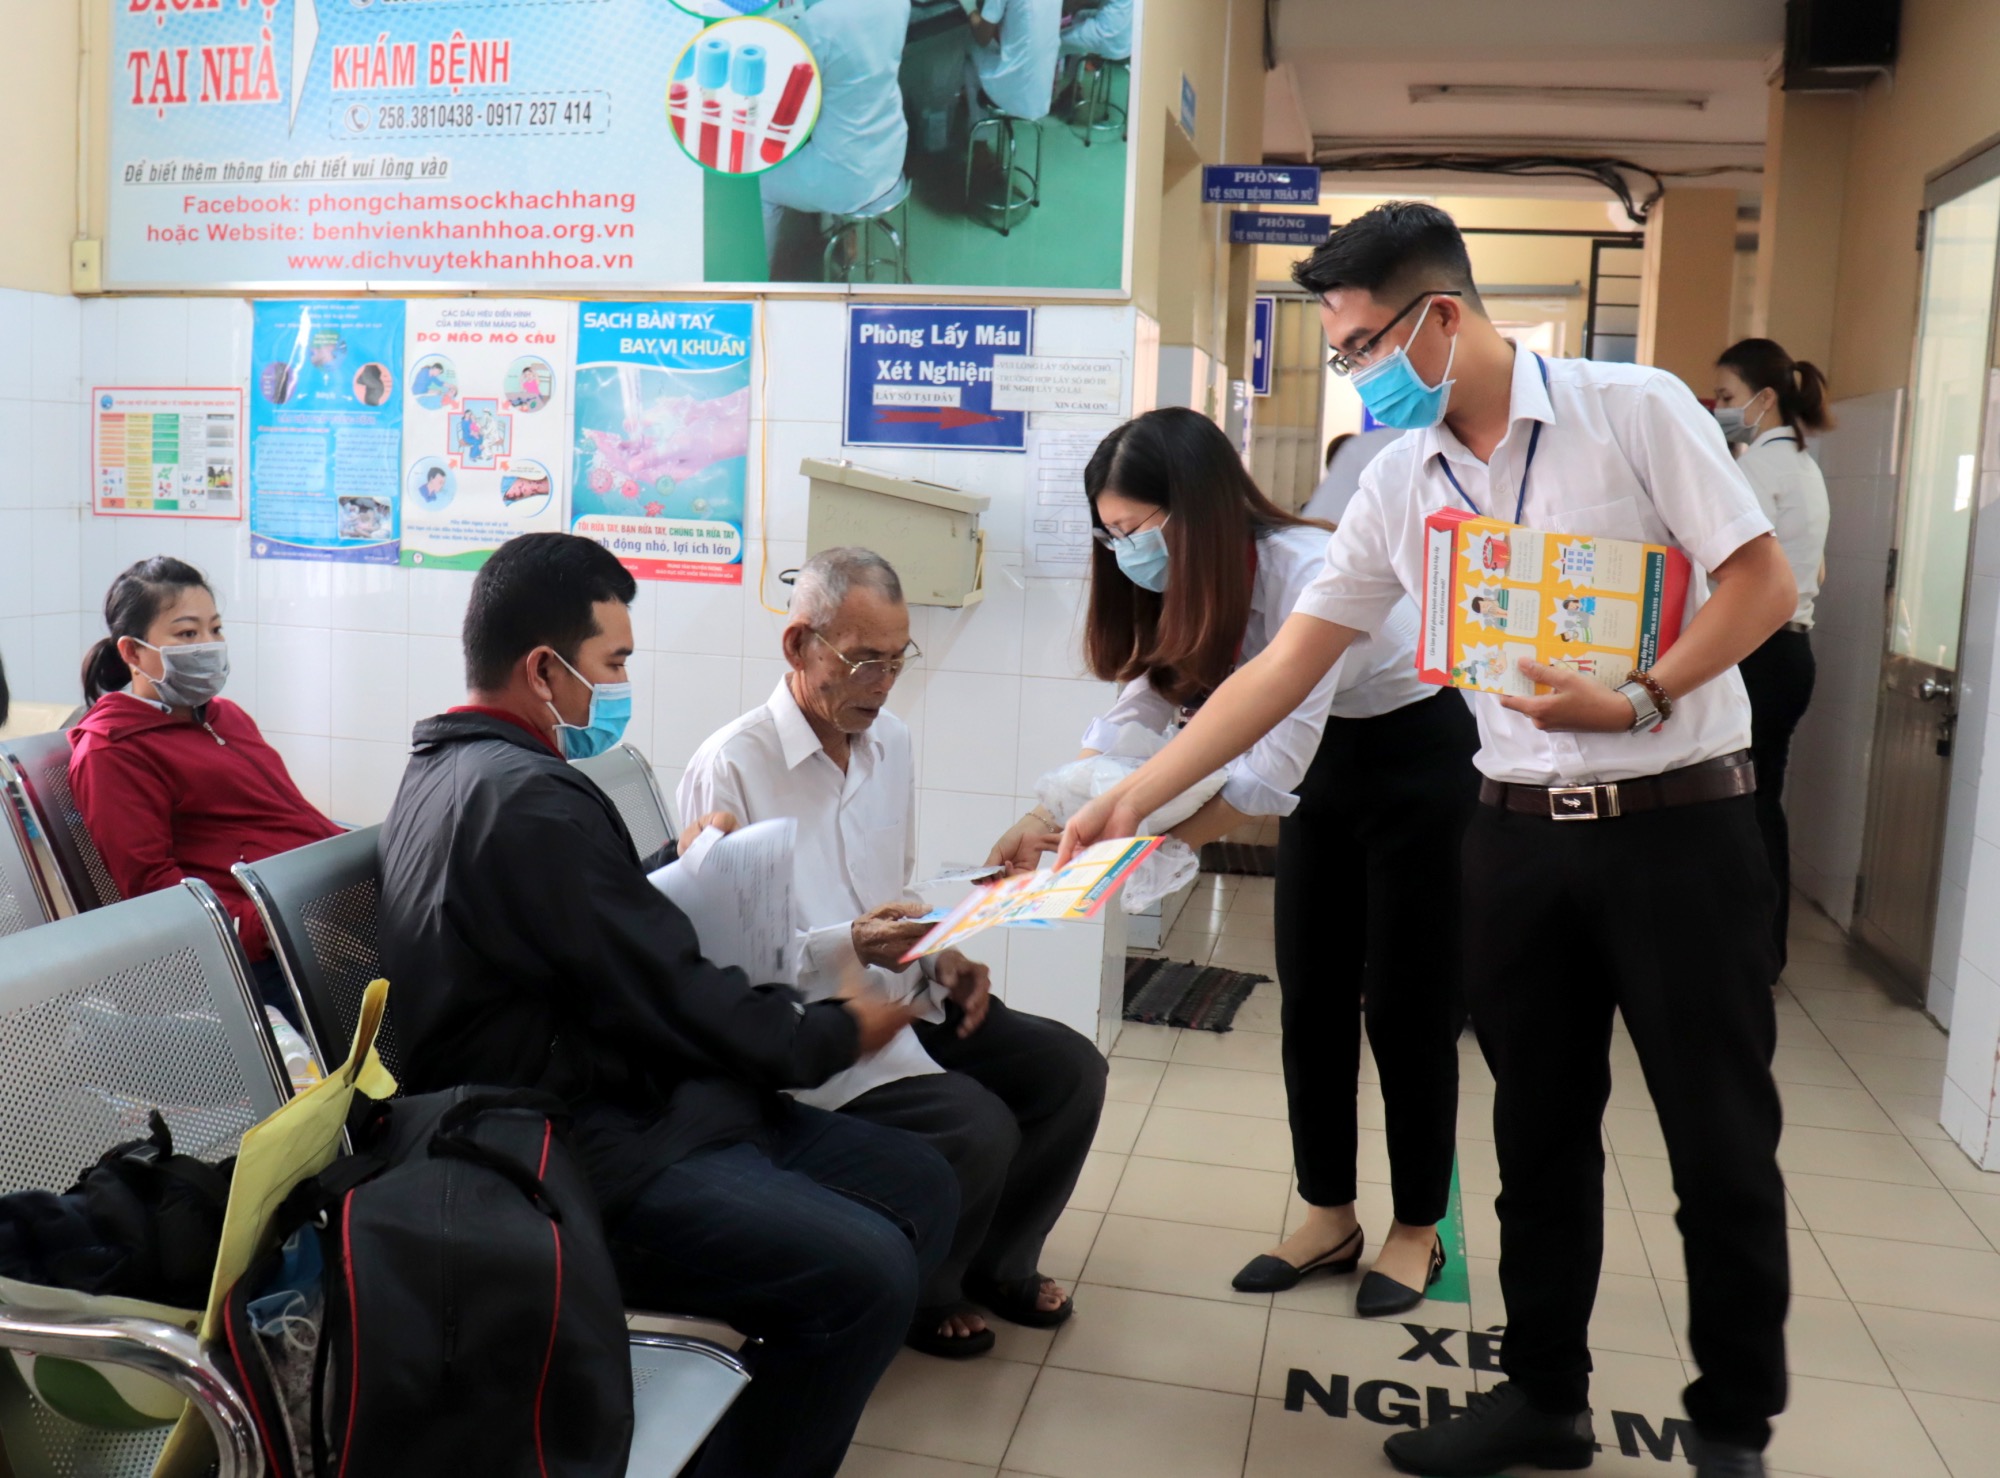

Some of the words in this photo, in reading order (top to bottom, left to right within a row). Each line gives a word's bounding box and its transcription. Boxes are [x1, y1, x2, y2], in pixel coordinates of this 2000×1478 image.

[128, 50, 188, 118] TẠI
[200, 27, 280, 102] NHÀ
[332, 34, 416, 89] KHÁM
[429, 31, 510, 93] BỆNH
[378, 104, 473, 129] 258.3810438
[486, 103, 523, 126] 0917
[529, 102, 557, 125] 237
[564, 101, 592, 124] 414
[124, 160, 146, 182] Để
[149, 161, 176, 181] biết
[181, 162, 217, 180] thêm
[223, 161, 263, 183] thông
[269, 161, 288, 179] tin
[293, 159, 315, 178] chi
[321, 156, 346, 178] tiết
[352, 158, 375, 178] vui
[380, 157, 414, 179] lòng
[420, 156, 448, 177] vào
[183, 194, 299, 214] Facebook:
[308, 190, 636, 216] phongchamsockhachhang
[147, 224, 200, 245] hoặc
[207, 223, 305, 241] Website:
[313, 220, 635, 243] benhvienkhanhhoa.org.vn
[1257, 216, 1306, 229] PHÒNG
[287, 250, 634, 274] www.dichvuytekhanhhoa.vn
[584, 312, 632, 332] SẠCH
[637, 309, 675, 329] BÀN
[679, 314, 715, 330] TAY
[417, 332, 441, 342] DO
[620, 338, 657, 353] BAY
[660, 339, 677, 355] VI
[681, 334, 745, 356] KHUẨN
[860, 323, 925, 348] Phòng
[931, 322, 968, 349] Lấy
[975, 325, 1021, 346] Máu
[876, 359, 913, 381] Xét
[919, 360, 993, 387] Nghiệm
